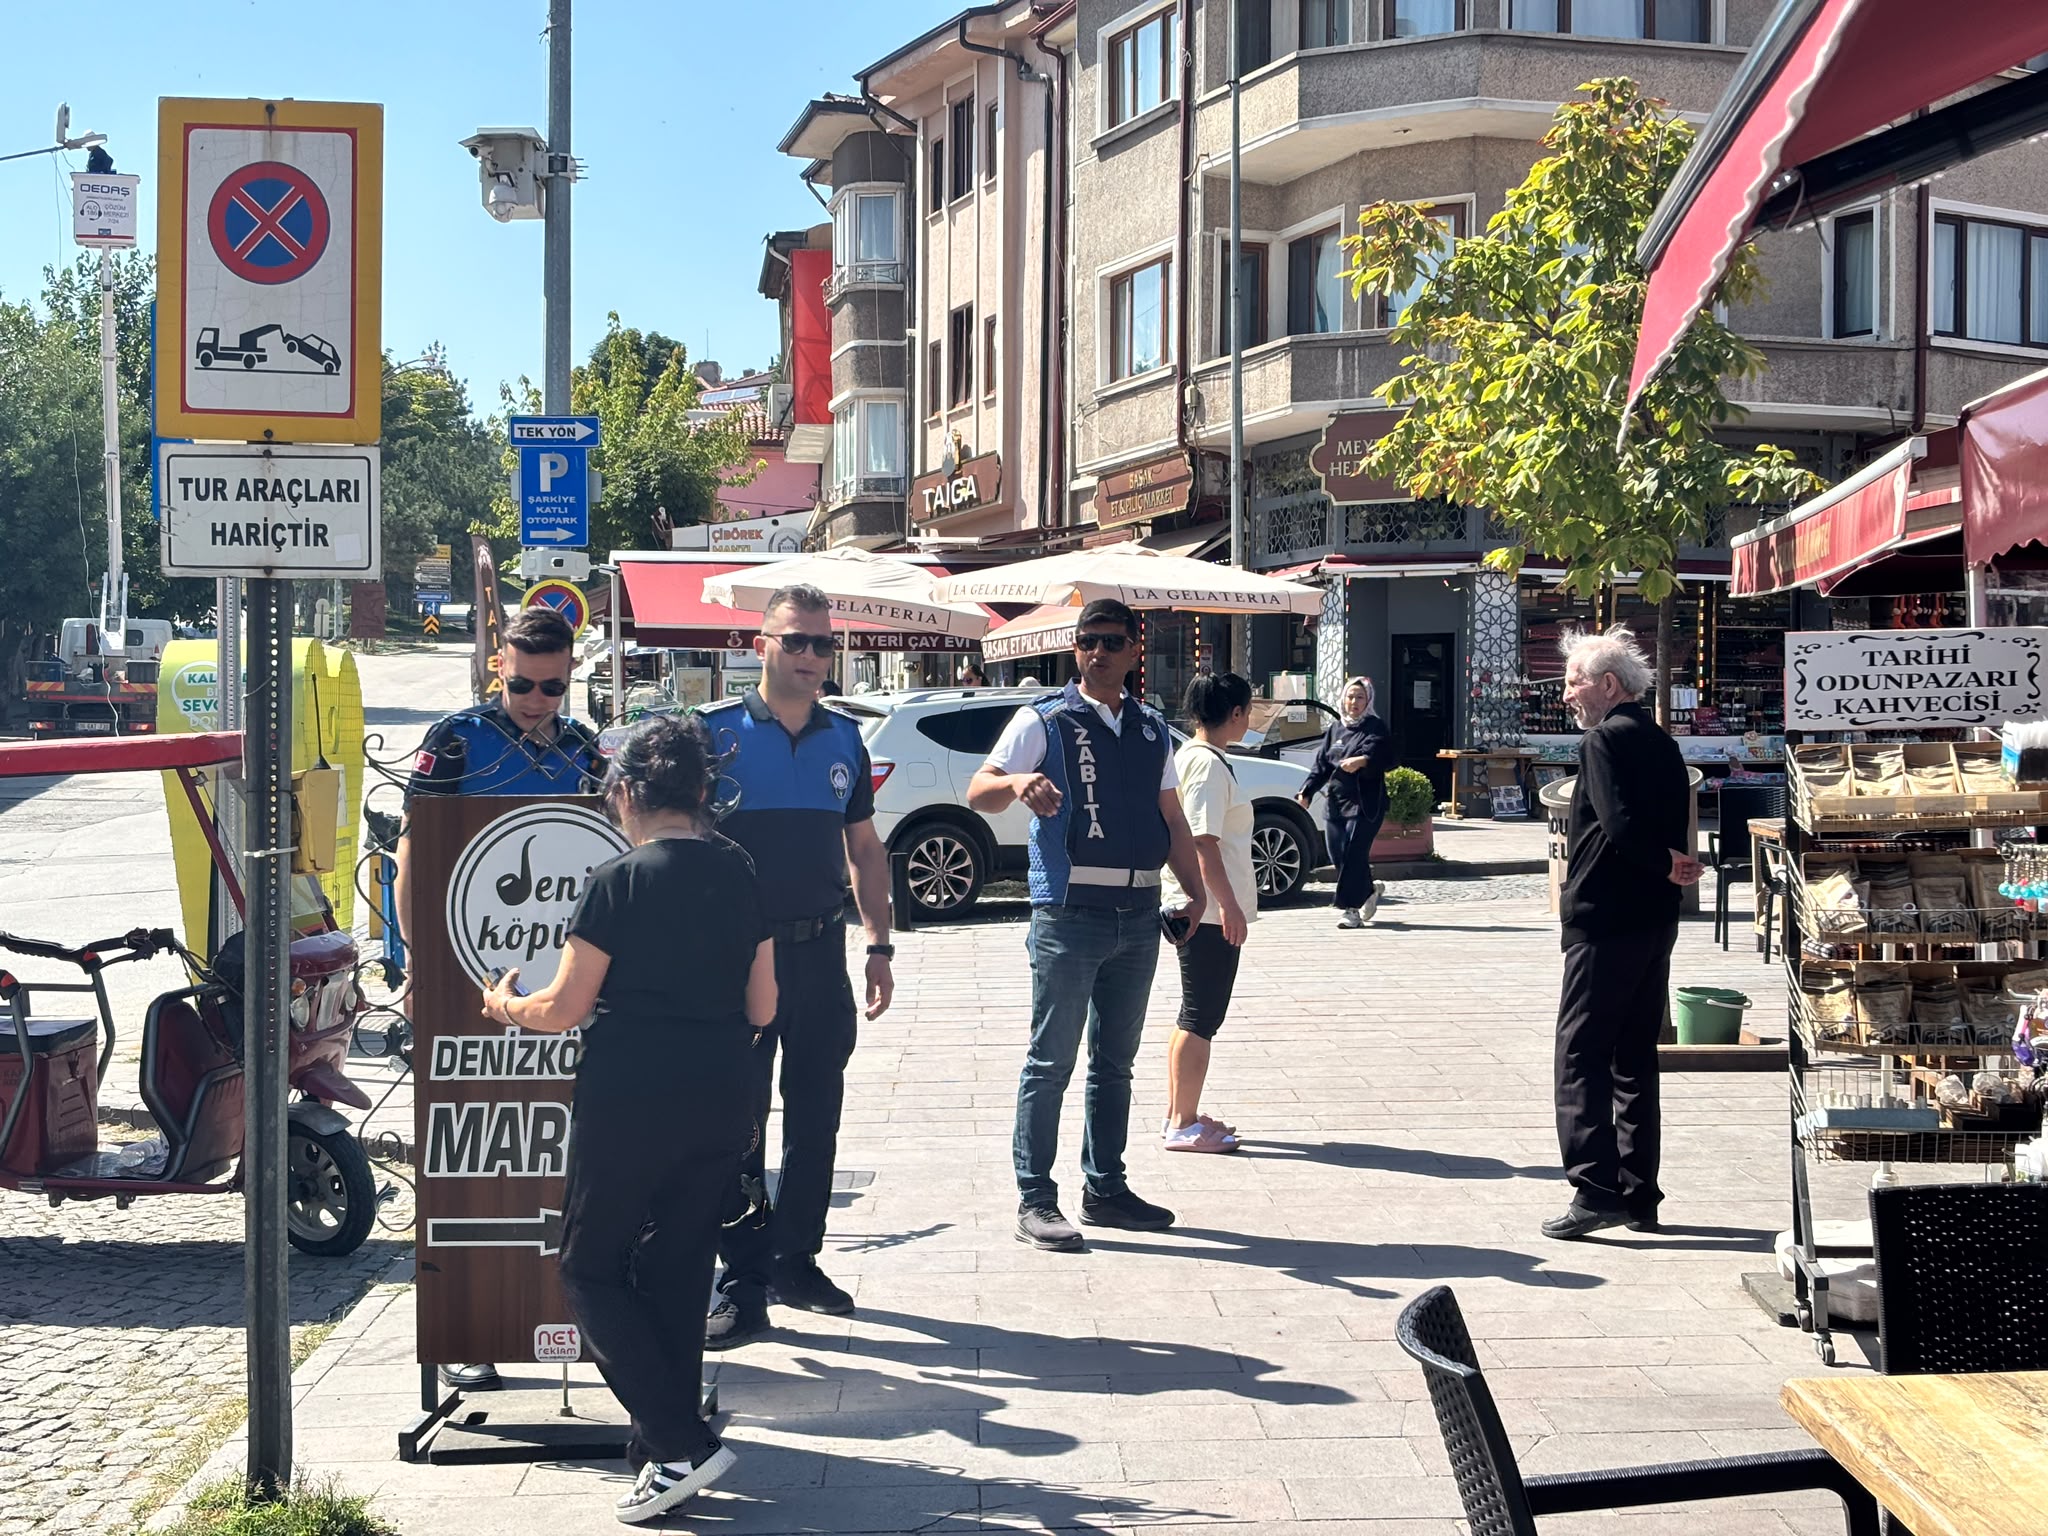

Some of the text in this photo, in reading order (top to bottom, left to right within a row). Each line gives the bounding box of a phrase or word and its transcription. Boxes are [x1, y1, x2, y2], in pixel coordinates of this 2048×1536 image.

[80, 184, 130, 197] DEDAŞ
[517, 423, 576, 437] TEK YÖN
[1336, 439, 1373, 456] MEY
[540, 453, 569, 492] P
[1129, 467, 1153, 490] BAŞAK
[178, 477, 360, 508] TUR ARAÇLARI
[527, 495, 576, 504] ŞARKİYE
[922, 474, 977, 513] TAIGA
[1144, 486, 1175, 509] MARKET
[536, 506, 568, 514] KATLI
[211, 516, 330, 553] HARİÇTİR
[711, 527, 764, 543] ÇİBÖREK
[953, 583, 1039, 597] LA GELATERIA
[1133, 588, 1281, 605] LA GELATERIA
[834, 635, 861, 647] RN
[866, 631, 903, 647] YERİ
[908, 636, 941, 650] ÇAY
[982, 639, 1009, 660] BAŞAK
[1010, 636, 1021, 655] ET
[1861, 643, 1972, 667] TARİHİ
[1816, 670, 2019, 692] ODUNPAZARI
[1833, 690, 2002, 715] KAHVECİSİ
[1074, 728, 1104, 839] ZABITA
[427, 1103, 570, 1174] MAR
[538, 1327, 576, 1345] net
